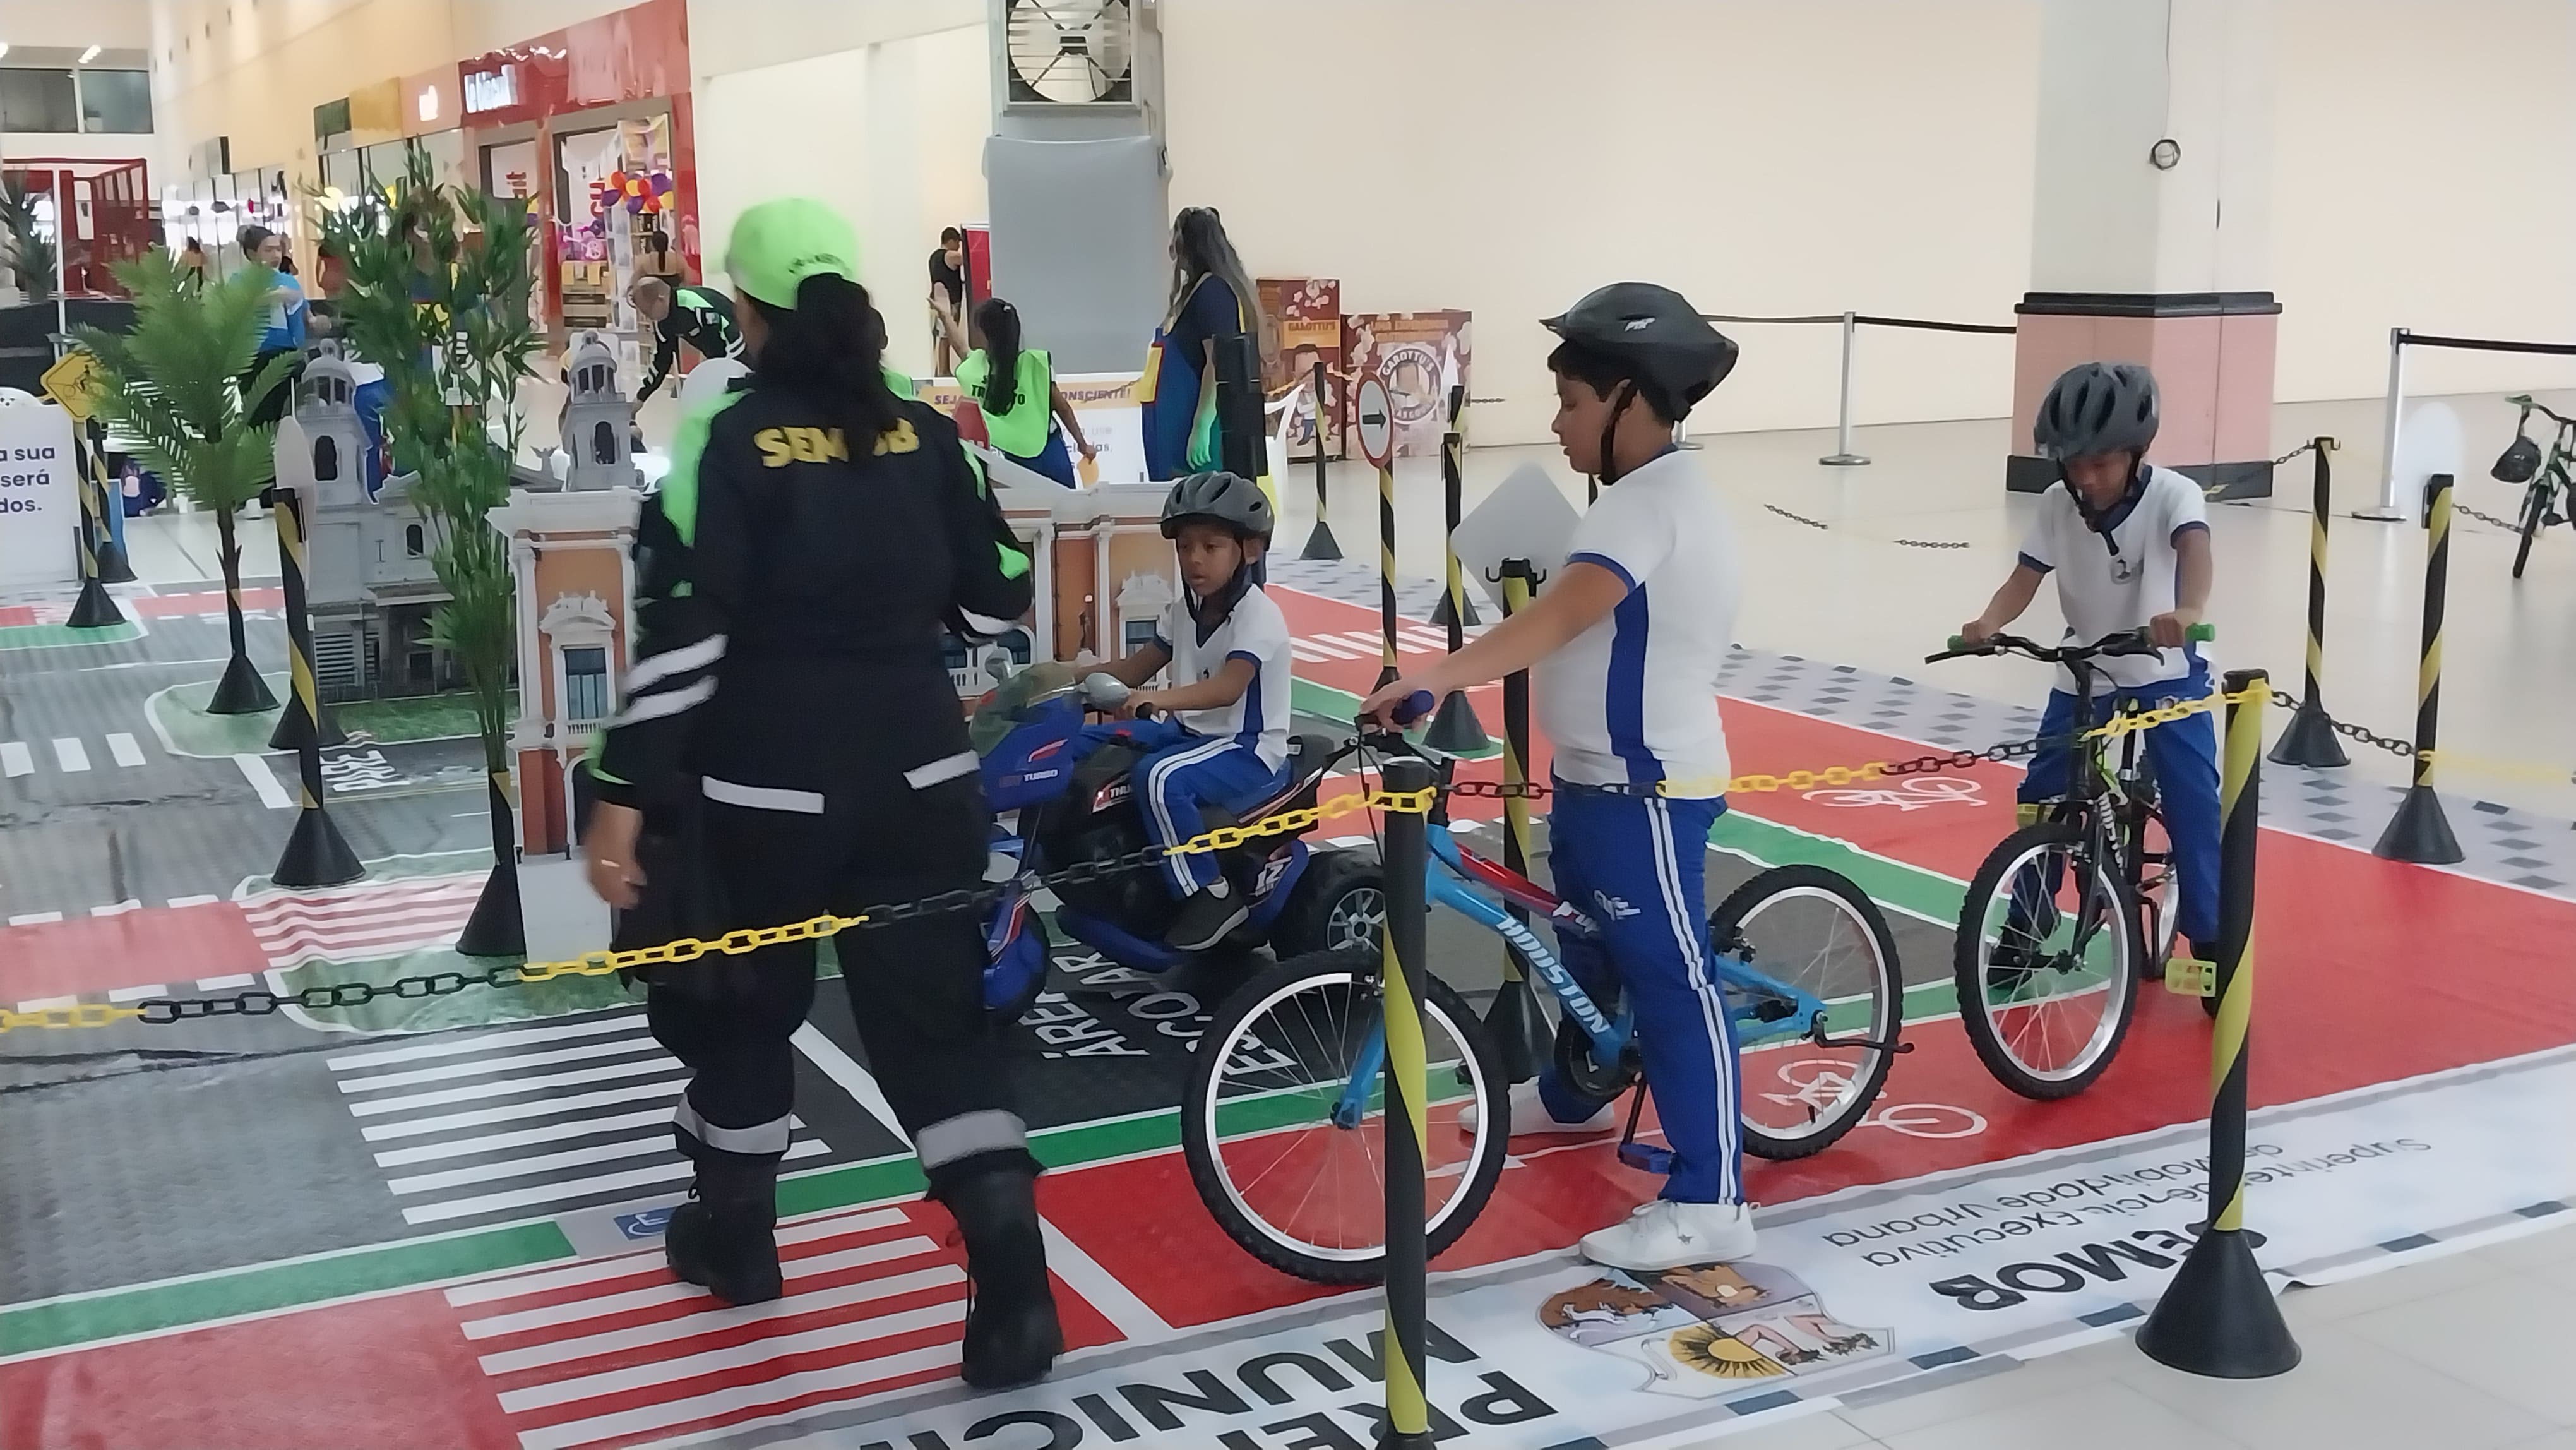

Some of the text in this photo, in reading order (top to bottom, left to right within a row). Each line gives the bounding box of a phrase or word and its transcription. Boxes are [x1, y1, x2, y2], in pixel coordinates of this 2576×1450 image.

[1382, 351, 1435, 376] GAROTTU'S
[934, 395, 957, 405] SEJ
[15, 447, 55, 460] sua
[1, 469, 50, 488] será
[1496, 916, 1611, 1033] HOUSTON
[1822, 1202, 1999, 1247] Urbana
[1861, 1211, 2084, 1267] Executiva
